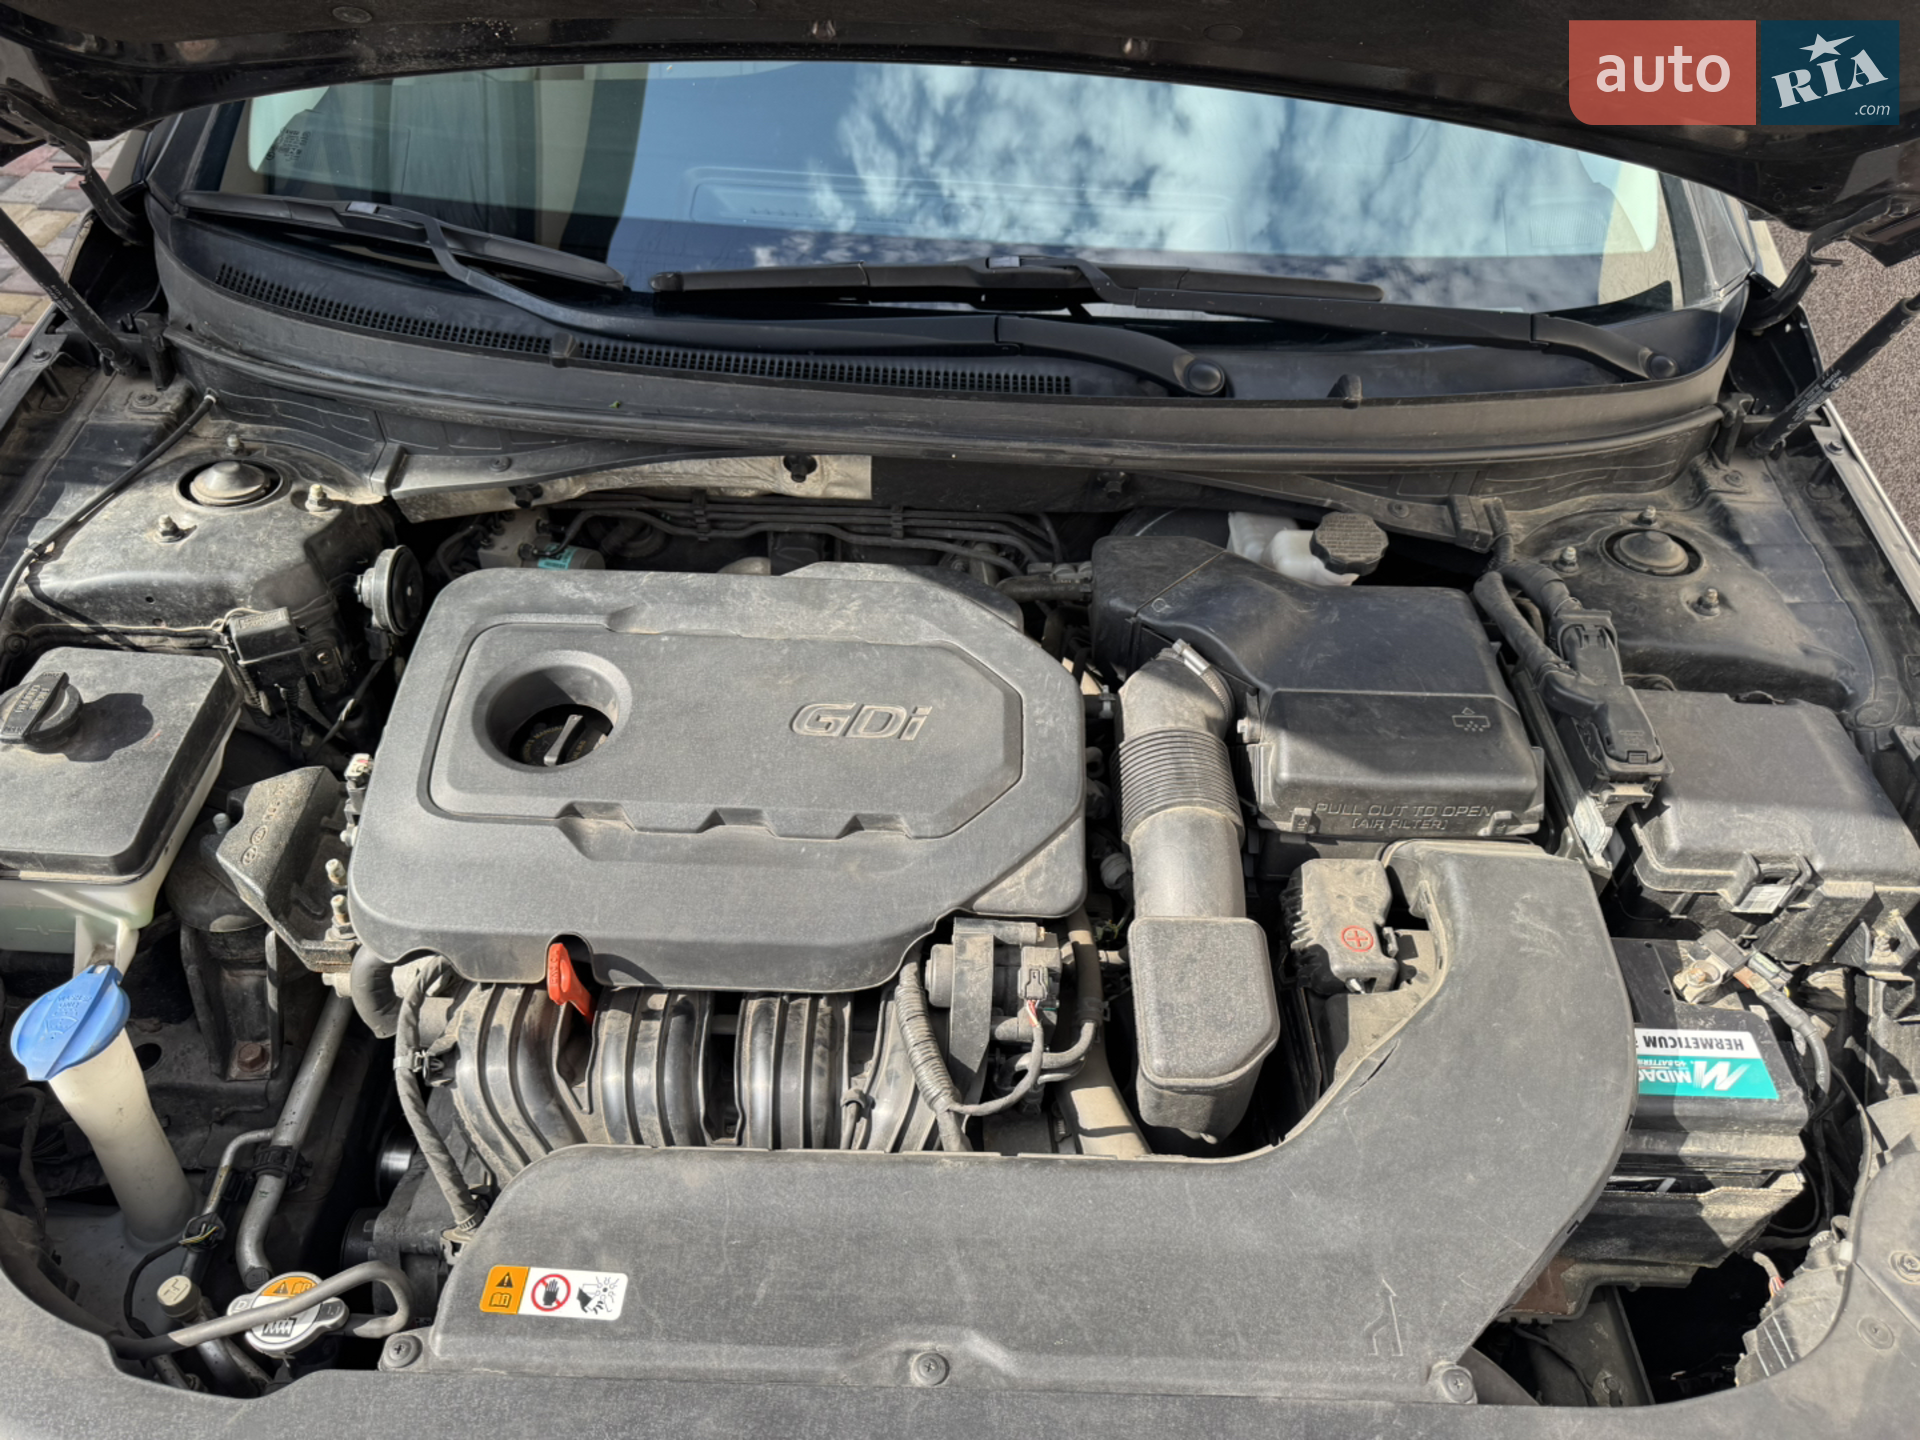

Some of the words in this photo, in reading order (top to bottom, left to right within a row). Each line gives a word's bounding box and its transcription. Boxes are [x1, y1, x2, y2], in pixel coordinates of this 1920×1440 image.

[790, 702, 933, 741] GDi
[1315, 803, 1363, 816] PULL
[1368, 804, 1408, 817] OUT
[1414, 806, 1439, 817] TO
[1441, 805, 1494, 817] OPEN
[1642, 1035, 1745, 1052] HERMETICUM
